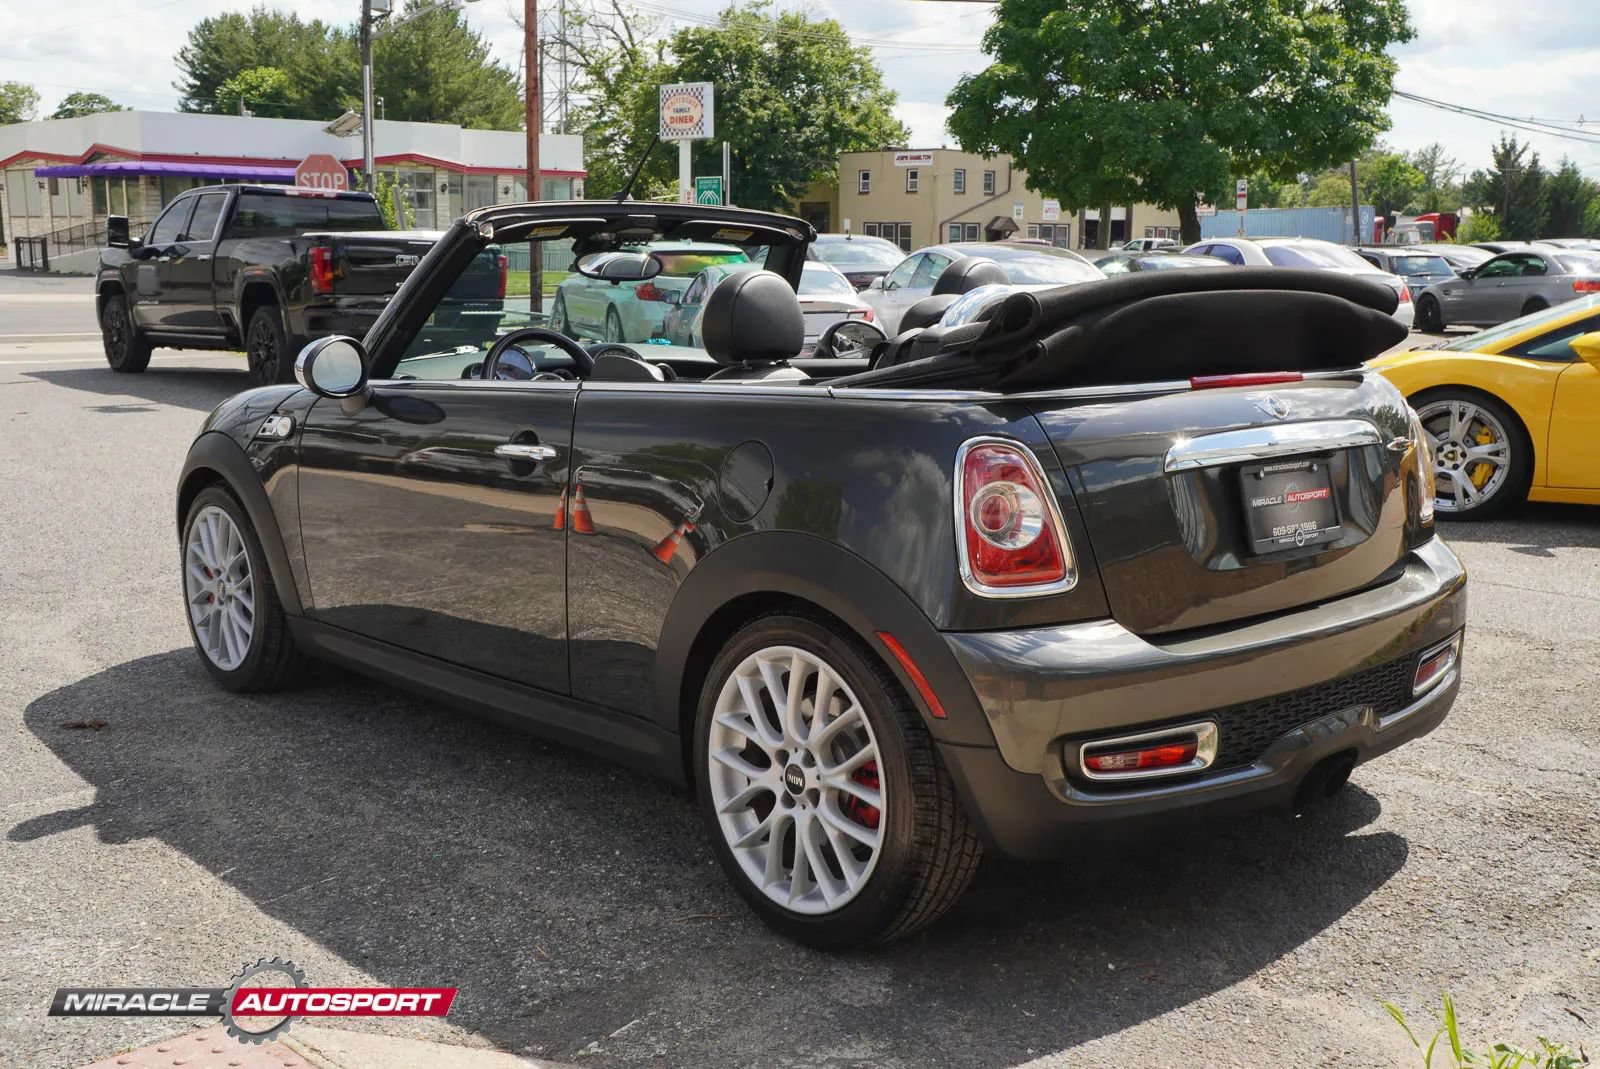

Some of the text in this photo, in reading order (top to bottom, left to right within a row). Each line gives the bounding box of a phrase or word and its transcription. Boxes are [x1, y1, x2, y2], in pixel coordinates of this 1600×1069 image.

[669, 115, 694, 124] DINER
[300, 172, 345, 189] STOP
[396, 255, 423, 266] GM
[1252, 489, 1327, 508] MIRACLE AUTOSPORT
[786, 773, 802, 786] MINI
